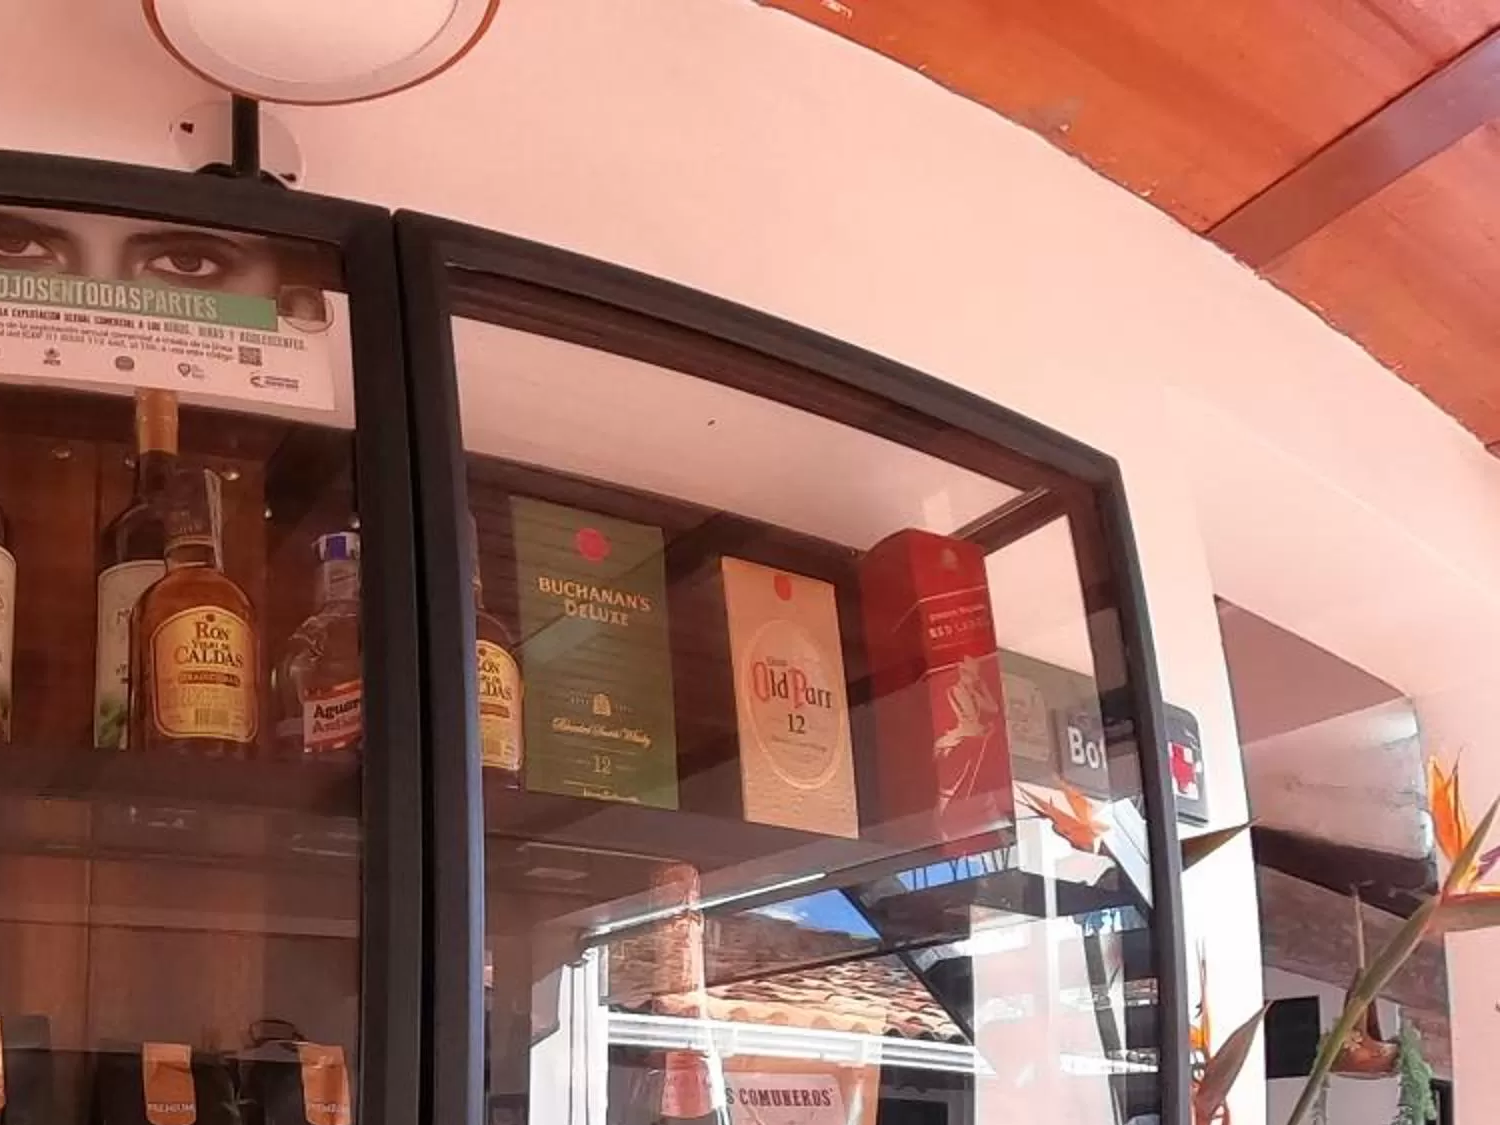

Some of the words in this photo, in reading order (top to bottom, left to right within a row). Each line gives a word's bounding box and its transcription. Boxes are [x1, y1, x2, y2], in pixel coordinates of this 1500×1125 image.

[538, 576, 651, 611] BUCHANAN'S
[564, 601, 629, 627] DELUXE
[753, 662, 788, 702] Old
[788, 667, 832, 709] Parr
[788, 713, 805, 734] 12
[592, 755, 612, 776] 12
[739, 1088, 832, 1107] COMUNEROS
